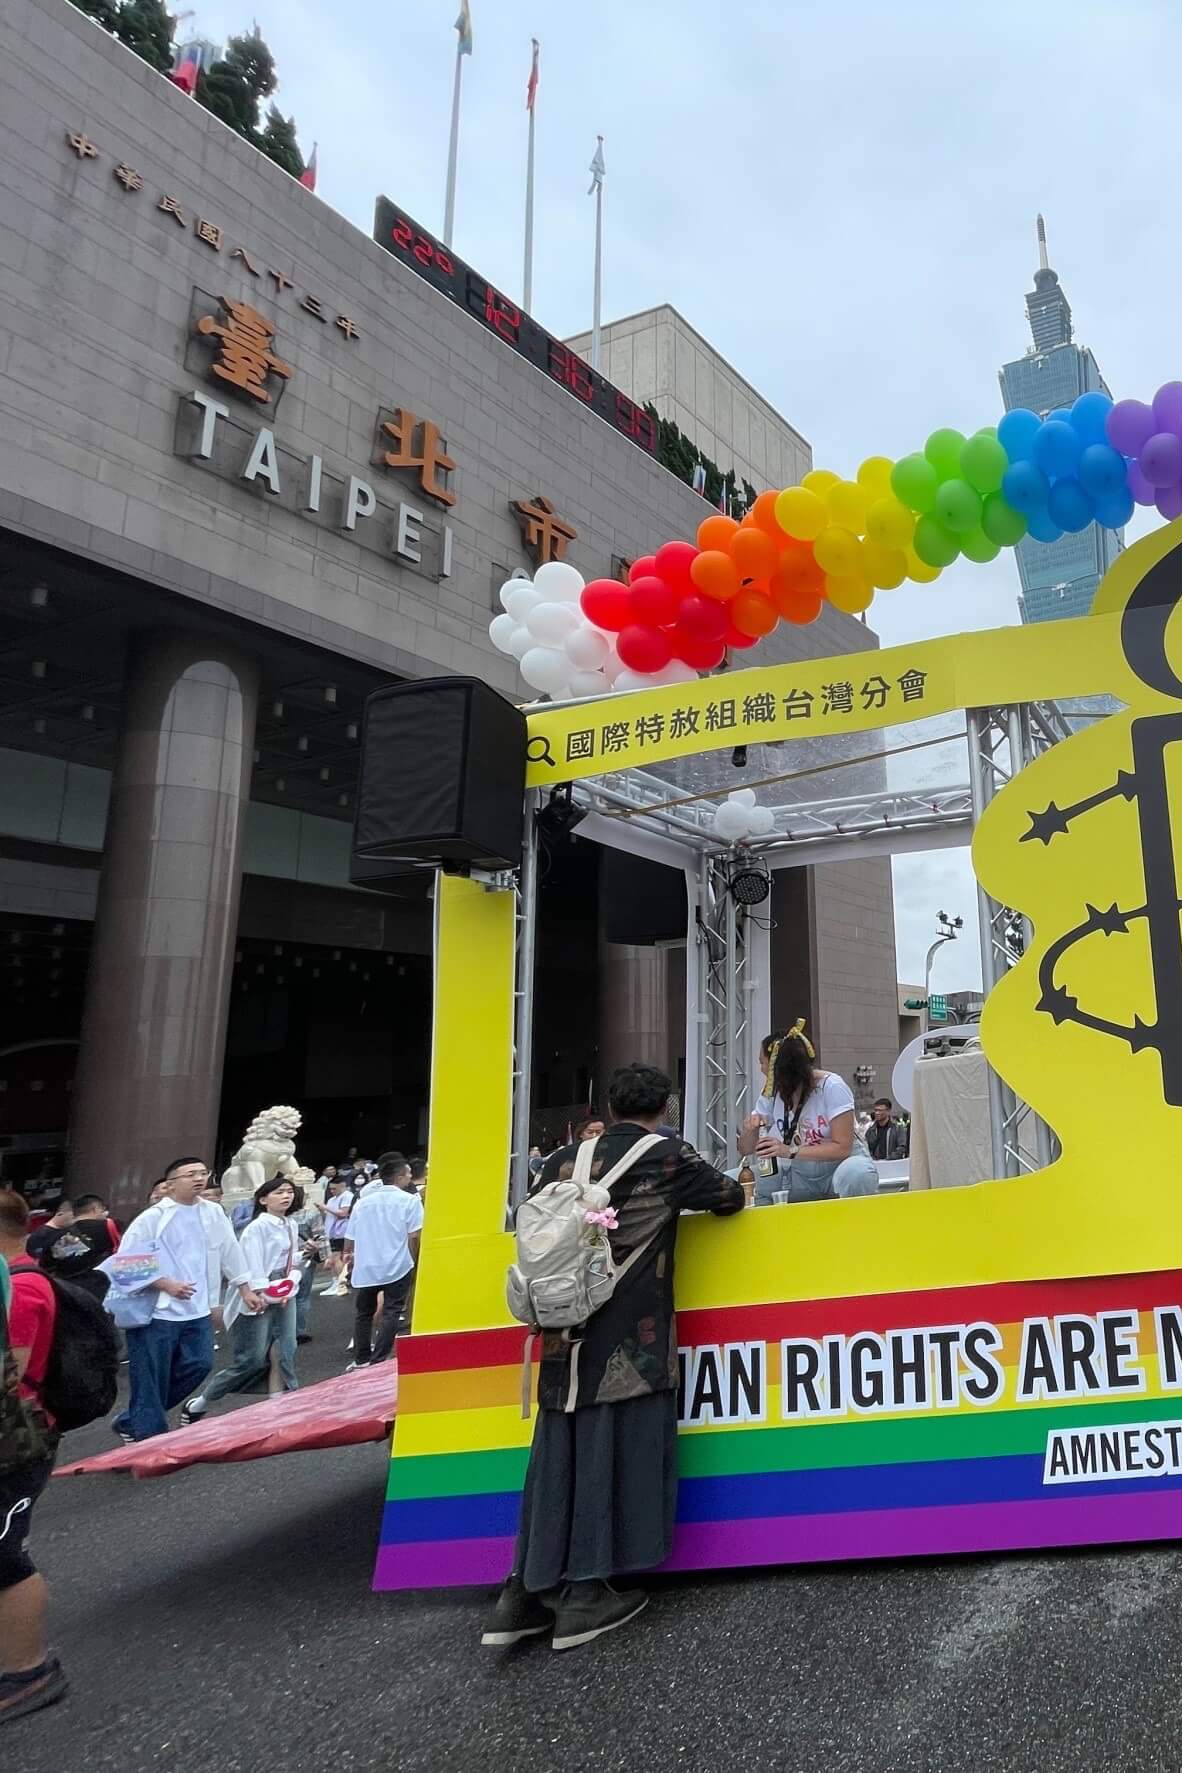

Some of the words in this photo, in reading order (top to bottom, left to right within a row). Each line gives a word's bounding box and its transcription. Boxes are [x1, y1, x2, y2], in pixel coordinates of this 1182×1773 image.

[66, 132, 360, 340] 中華民國八十三年
[187, 391, 454, 578] TAIPEI
[198, 295, 633, 586] 臺北市
[566, 669, 928, 763] 國際特赦組織台灣分會
[786, 1329, 999, 1413] RIGHTS
[1022, 1317, 1139, 1395] ARE
